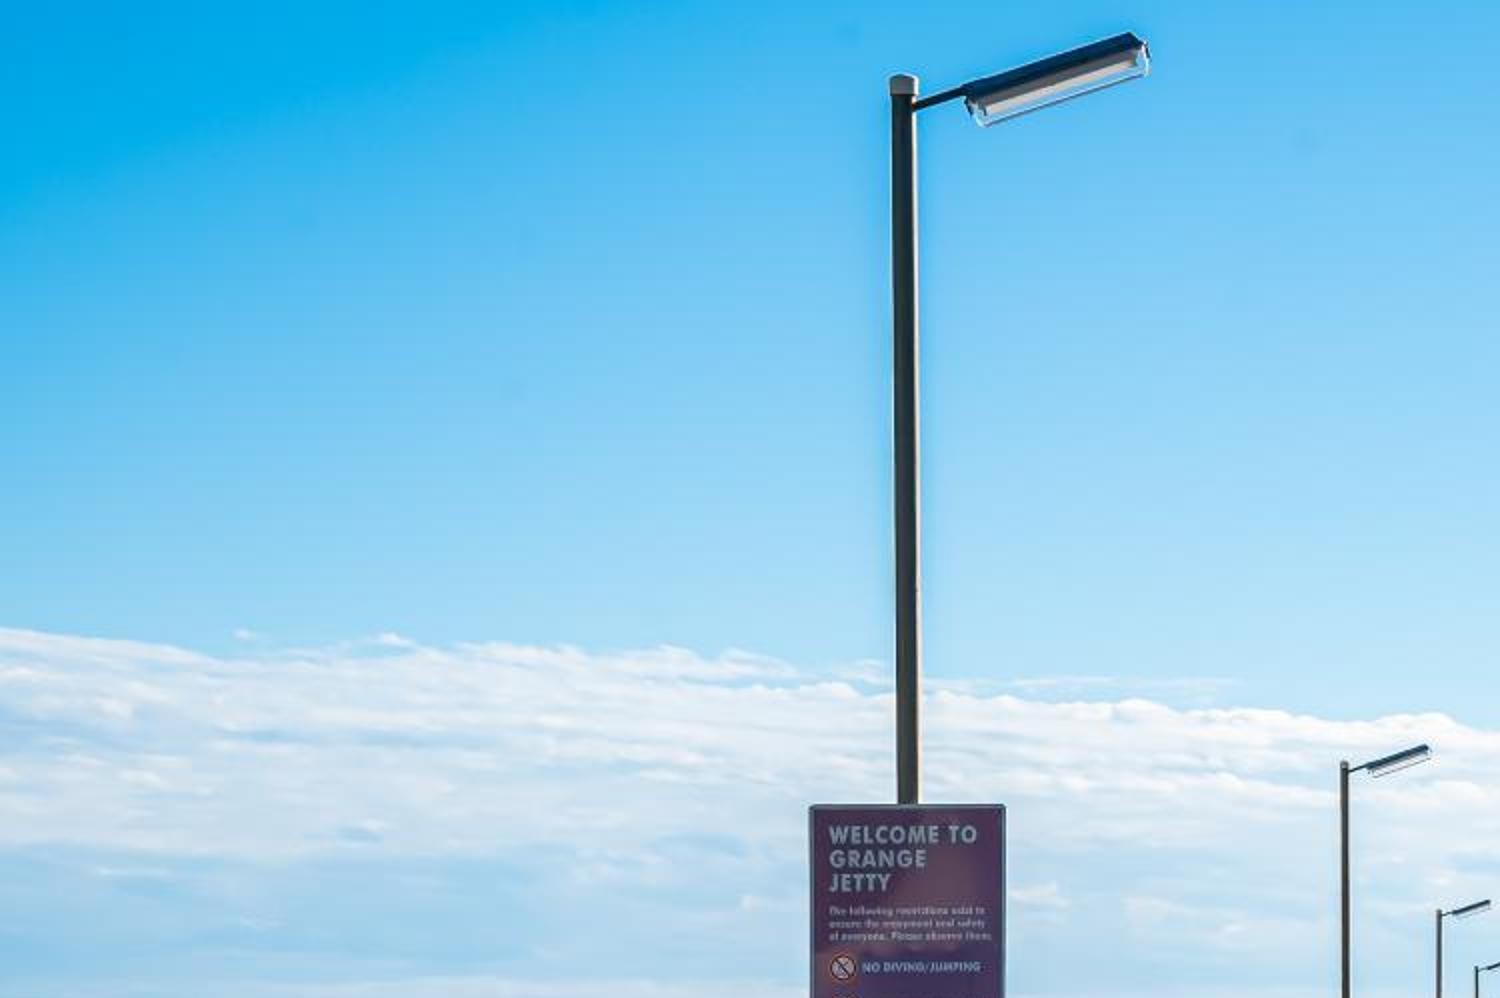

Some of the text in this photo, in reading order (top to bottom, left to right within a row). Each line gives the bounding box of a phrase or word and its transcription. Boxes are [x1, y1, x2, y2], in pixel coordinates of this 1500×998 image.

[829, 825, 977, 844] WELCOME TO
[829, 849, 927, 868] GRANGE
[829, 873, 891, 892] JETTY
[862, 962, 981, 973] NO DIVING/JUMPING
